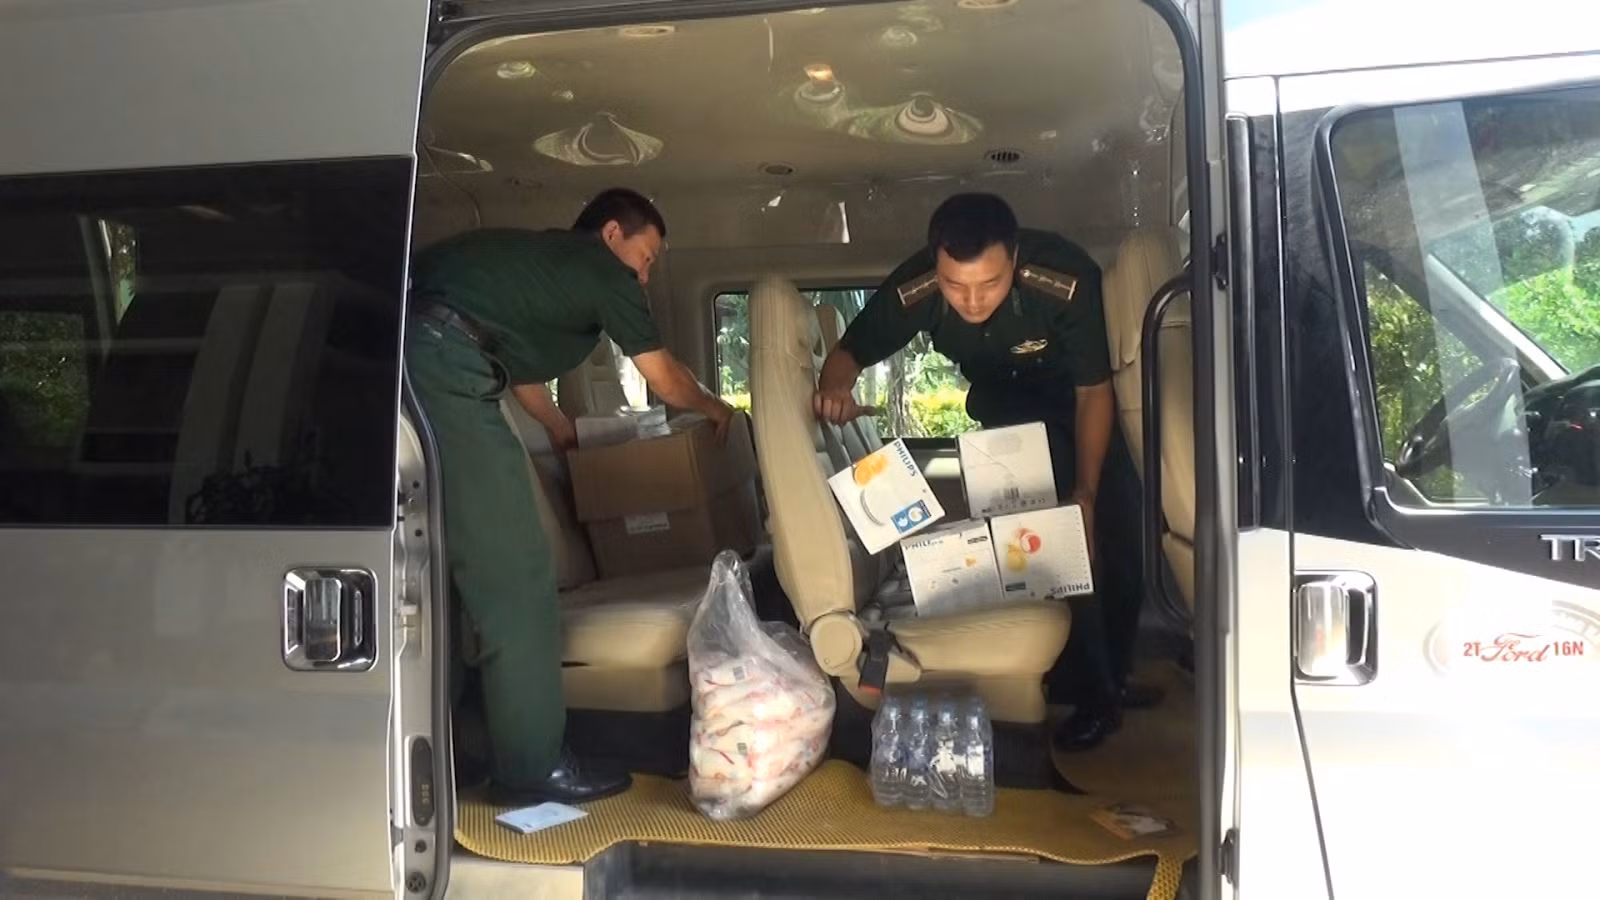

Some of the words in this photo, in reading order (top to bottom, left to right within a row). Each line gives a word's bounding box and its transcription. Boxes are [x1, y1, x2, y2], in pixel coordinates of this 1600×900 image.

[893, 441, 918, 477] PHILIPS
[1050, 582, 1090, 595] PHILIPS
[1463, 642, 1482, 656] 2T
[1481, 633, 1550, 662] Ford
[1554, 641, 1584, 656] 16N
